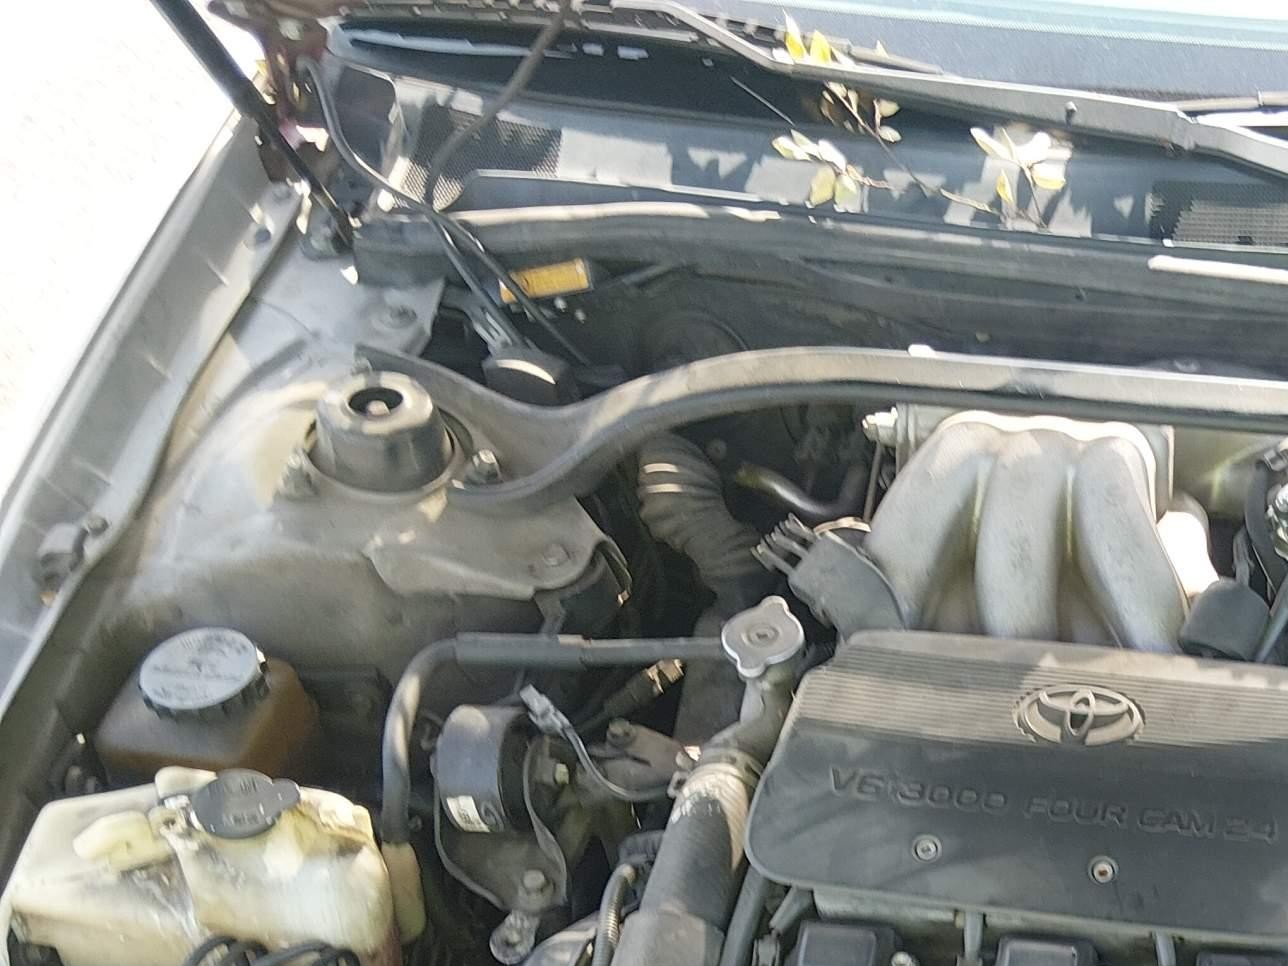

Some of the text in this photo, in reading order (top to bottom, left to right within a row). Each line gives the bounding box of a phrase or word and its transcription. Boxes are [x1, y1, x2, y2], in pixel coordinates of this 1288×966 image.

[830, 766, 885, 802] V6
[896, 780, 1009, 815] 3000
[1023, 796, 1129, 829] FOUR
[1138, 808, 1215, 838] CAM
